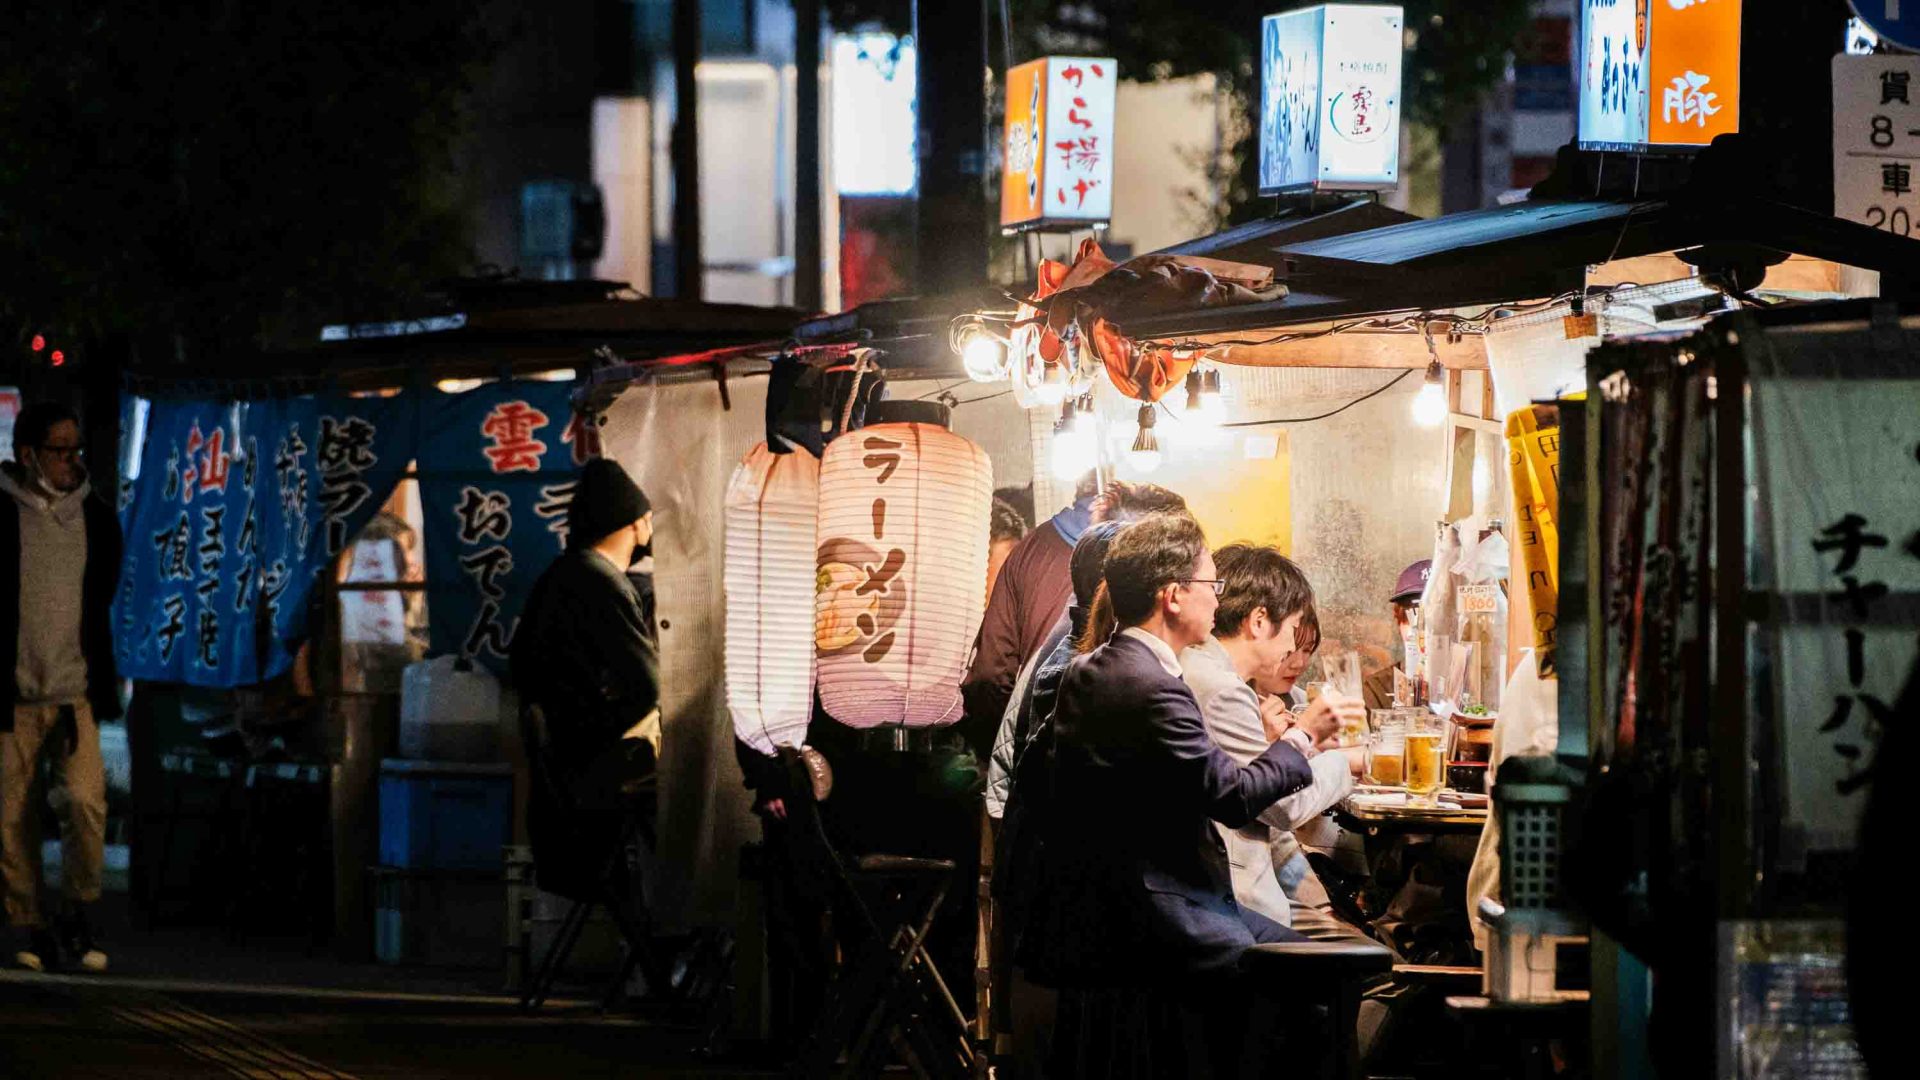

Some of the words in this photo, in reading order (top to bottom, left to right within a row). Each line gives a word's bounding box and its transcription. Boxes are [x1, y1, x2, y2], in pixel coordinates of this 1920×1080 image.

[1055, 64, 1103, 210] から揚げ
[1664, 70, 1722, 127] 豚
[1880, 70, 1911, 105] 貨
[1881, 162, 1912, 196] 車
[455, 486, 521, 657] おでん
[856, 437, 906, 664] ラーメン
